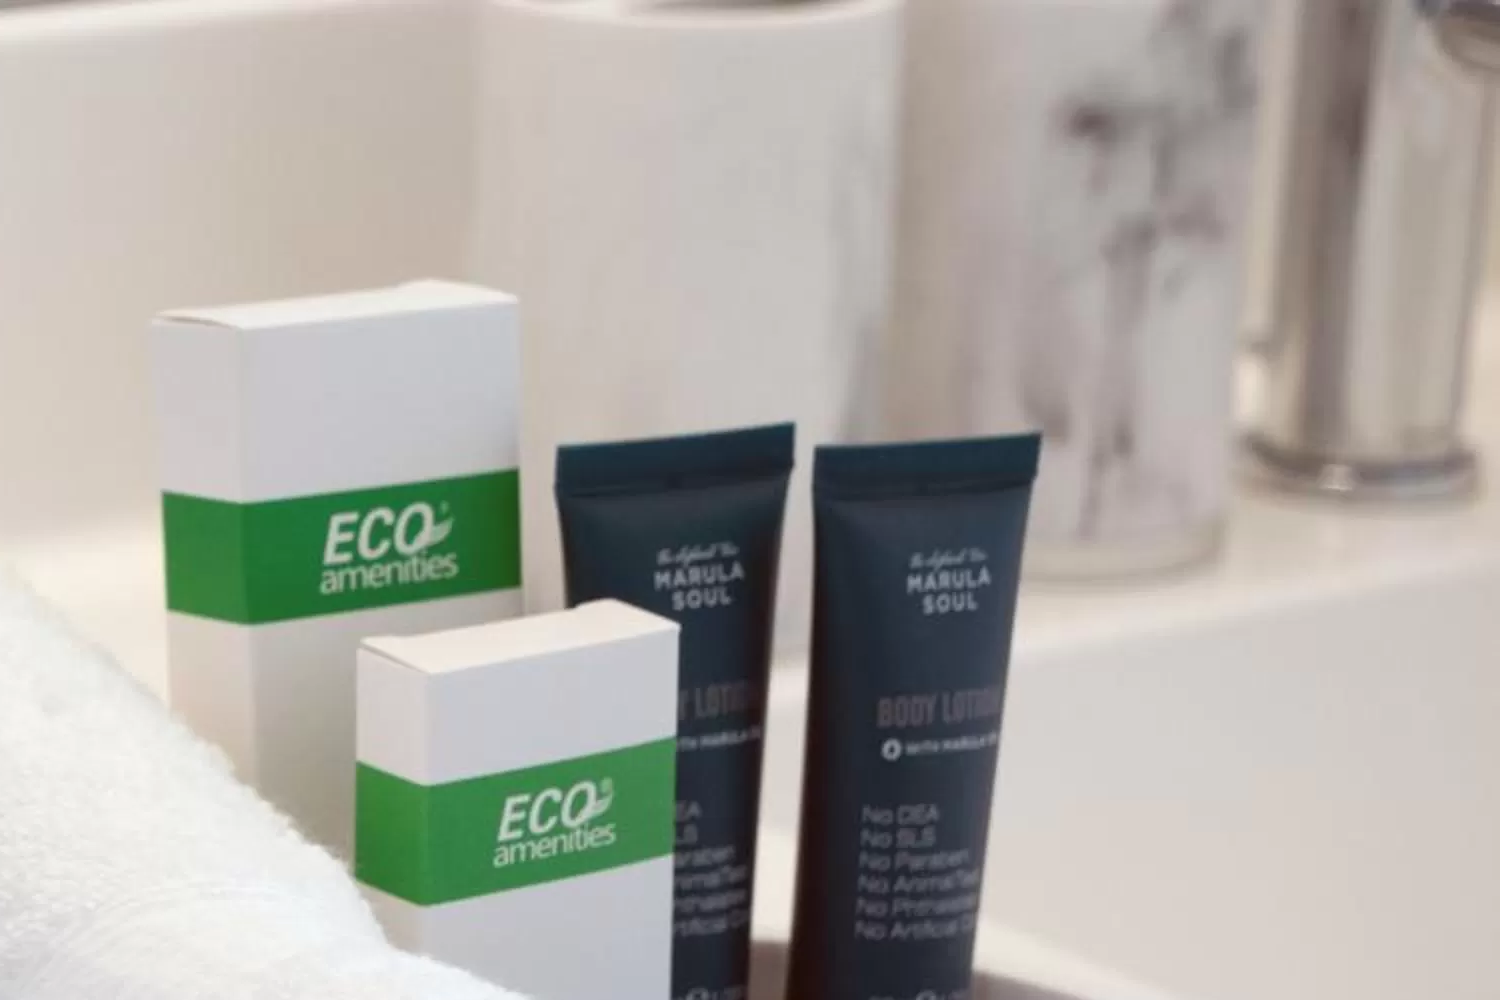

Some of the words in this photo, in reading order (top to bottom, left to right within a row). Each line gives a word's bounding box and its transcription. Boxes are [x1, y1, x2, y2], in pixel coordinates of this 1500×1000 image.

[322, 502, 438, 566] ECO
[319, 551, 459, 596] amenities
[653, 560, 745, 592] MARULA
[906, 565, 992, 596] MARULA
[672, 586, 732, 611] SOUL
[923, 591, 979, 616] SOUL
[876, 693, 937, 729] BODY
[496, 780, 600, 843] ECO
[862, 804, 894, 826] No
[493, 824, 616, 868] amenities
[860, 828, 893, 848] No
